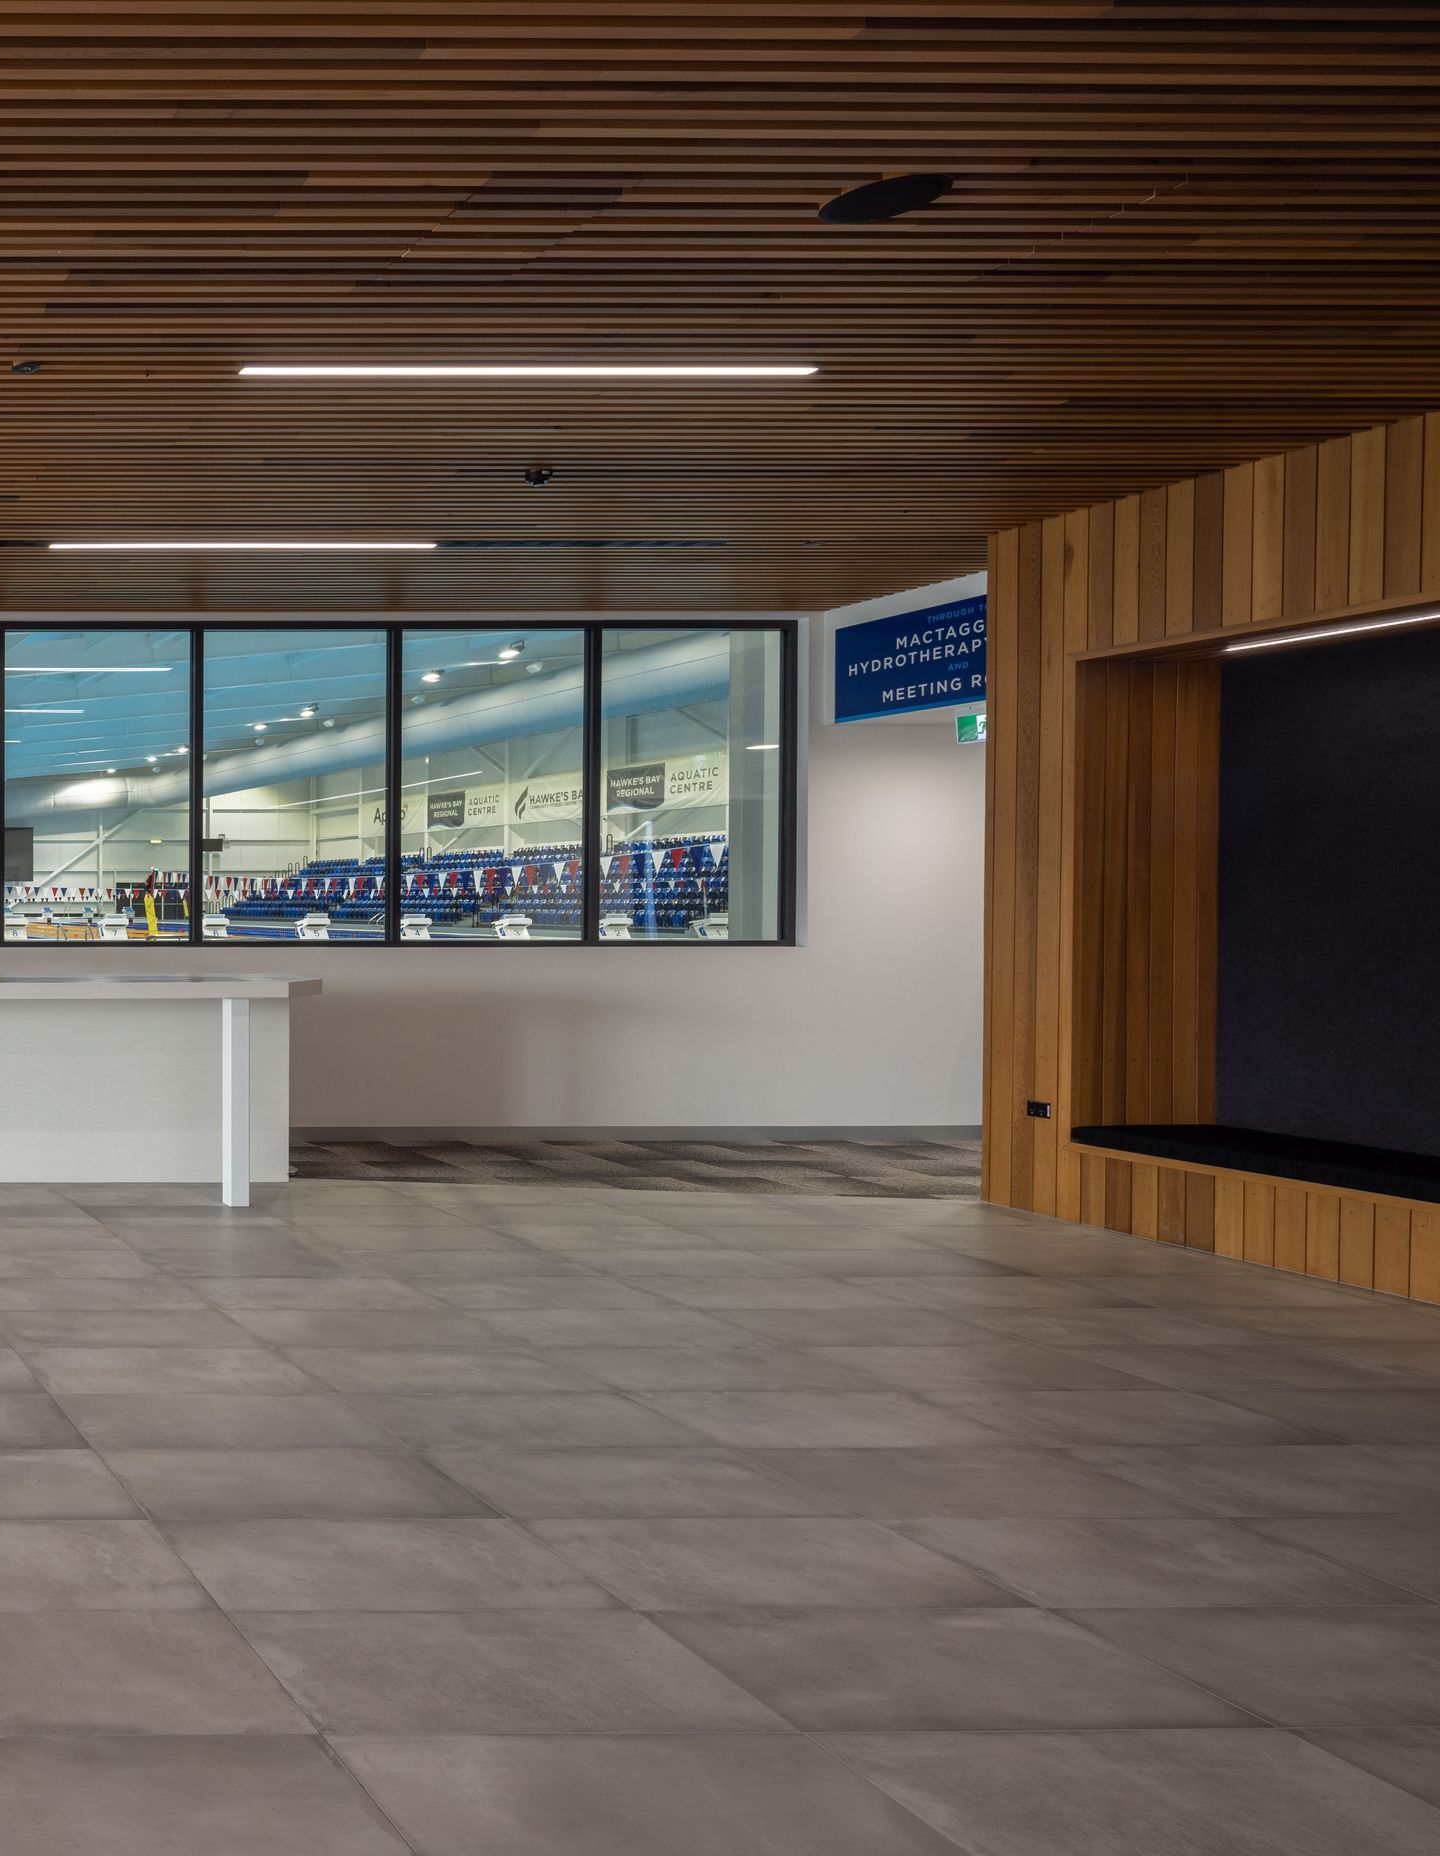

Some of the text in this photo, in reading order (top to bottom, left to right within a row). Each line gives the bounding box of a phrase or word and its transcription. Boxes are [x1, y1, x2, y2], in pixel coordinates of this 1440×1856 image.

[927, 602, 988, 623] THROUGH T
[848, 637, 988, 677] HYDROTHERAP
[947, 661, 969, 672] AND
[882, 674, 987, 703] MEETING R
[610, 774, 661, 788] HAWKE'S BAY
[670, 767, 719, 782] AQUATIC
[616, 786, 655, 798] REGIONAL
[669, 781, 713, 794] CENTRE
[429, 799, 463, 810] HAWKE'S BAY
[467, 794, 500, 806] AQUATIC
[529, 791, 569, 805] HAWKE'S
[433, 809, 458, 818] REGIONAL
[467, 805, 496, 816] CENTRE
